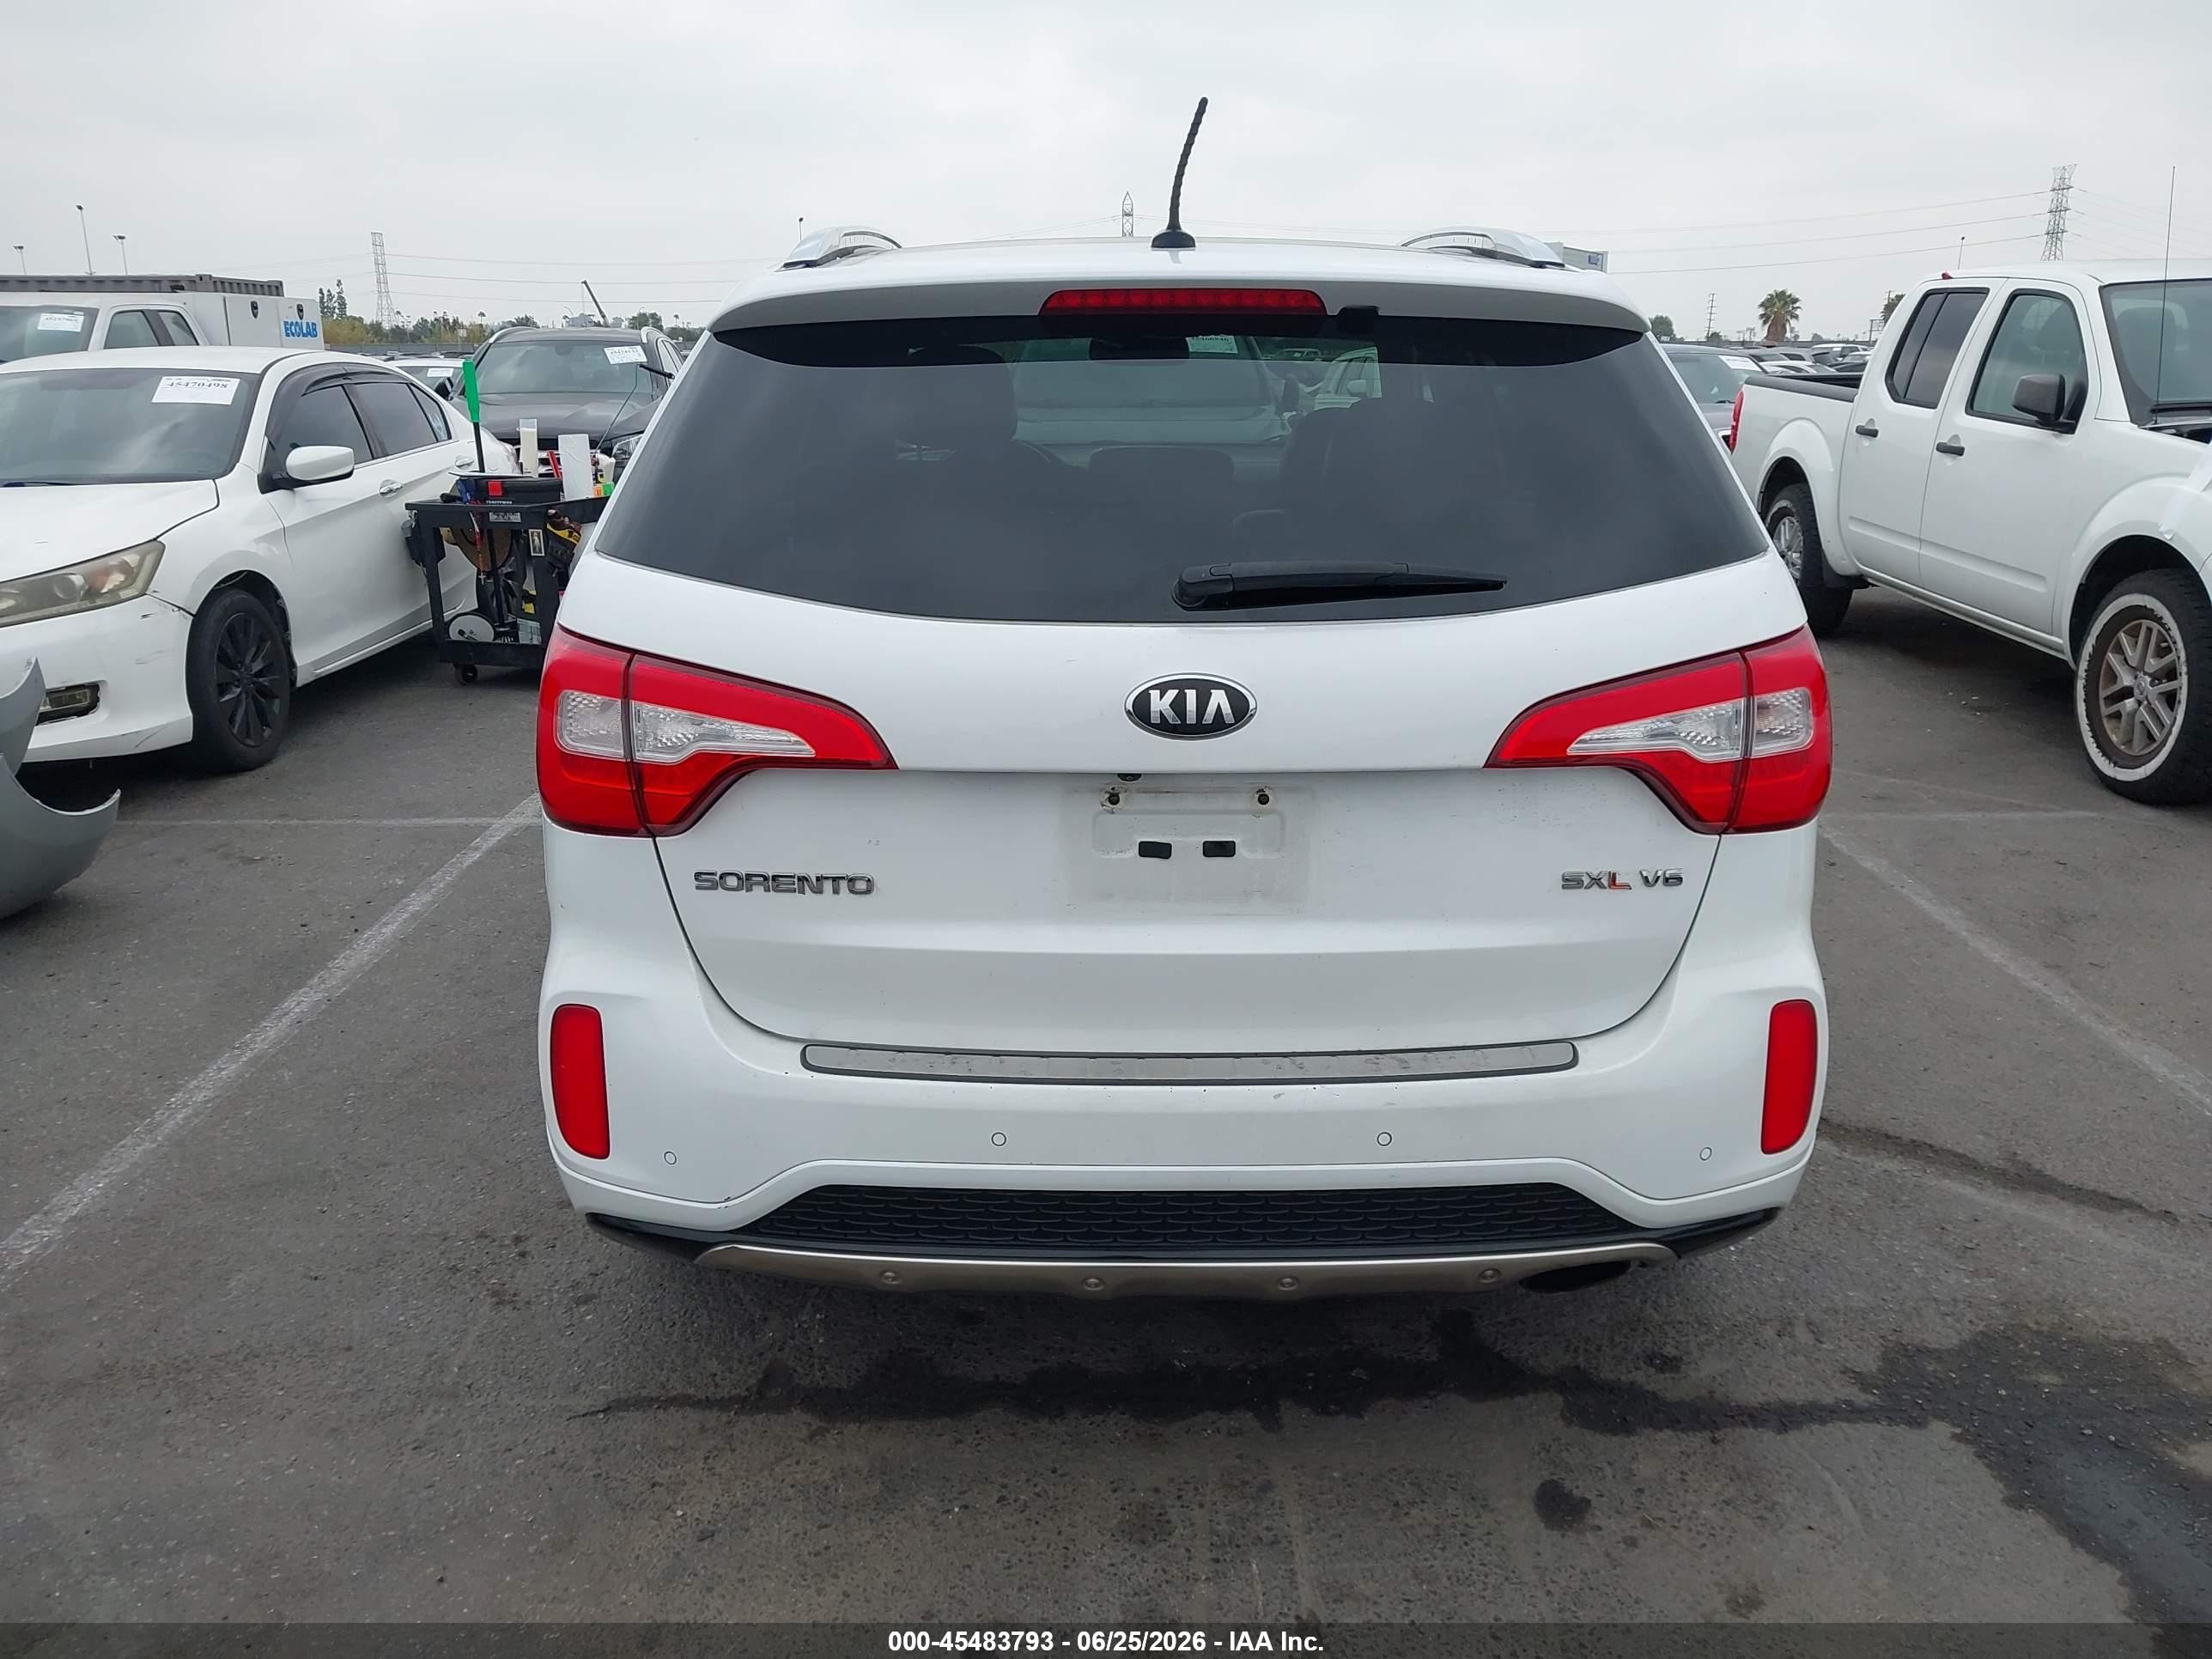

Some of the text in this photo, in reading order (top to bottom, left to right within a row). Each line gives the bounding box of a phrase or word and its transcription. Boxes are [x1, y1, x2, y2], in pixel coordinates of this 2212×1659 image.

[283, 320, 318, 338] ECOLAB
[1148, 689, 1236, 725] KIA
[694, 870, 875, 896] SORENTO
[1561, 867, 1684, 890] SXL V6
